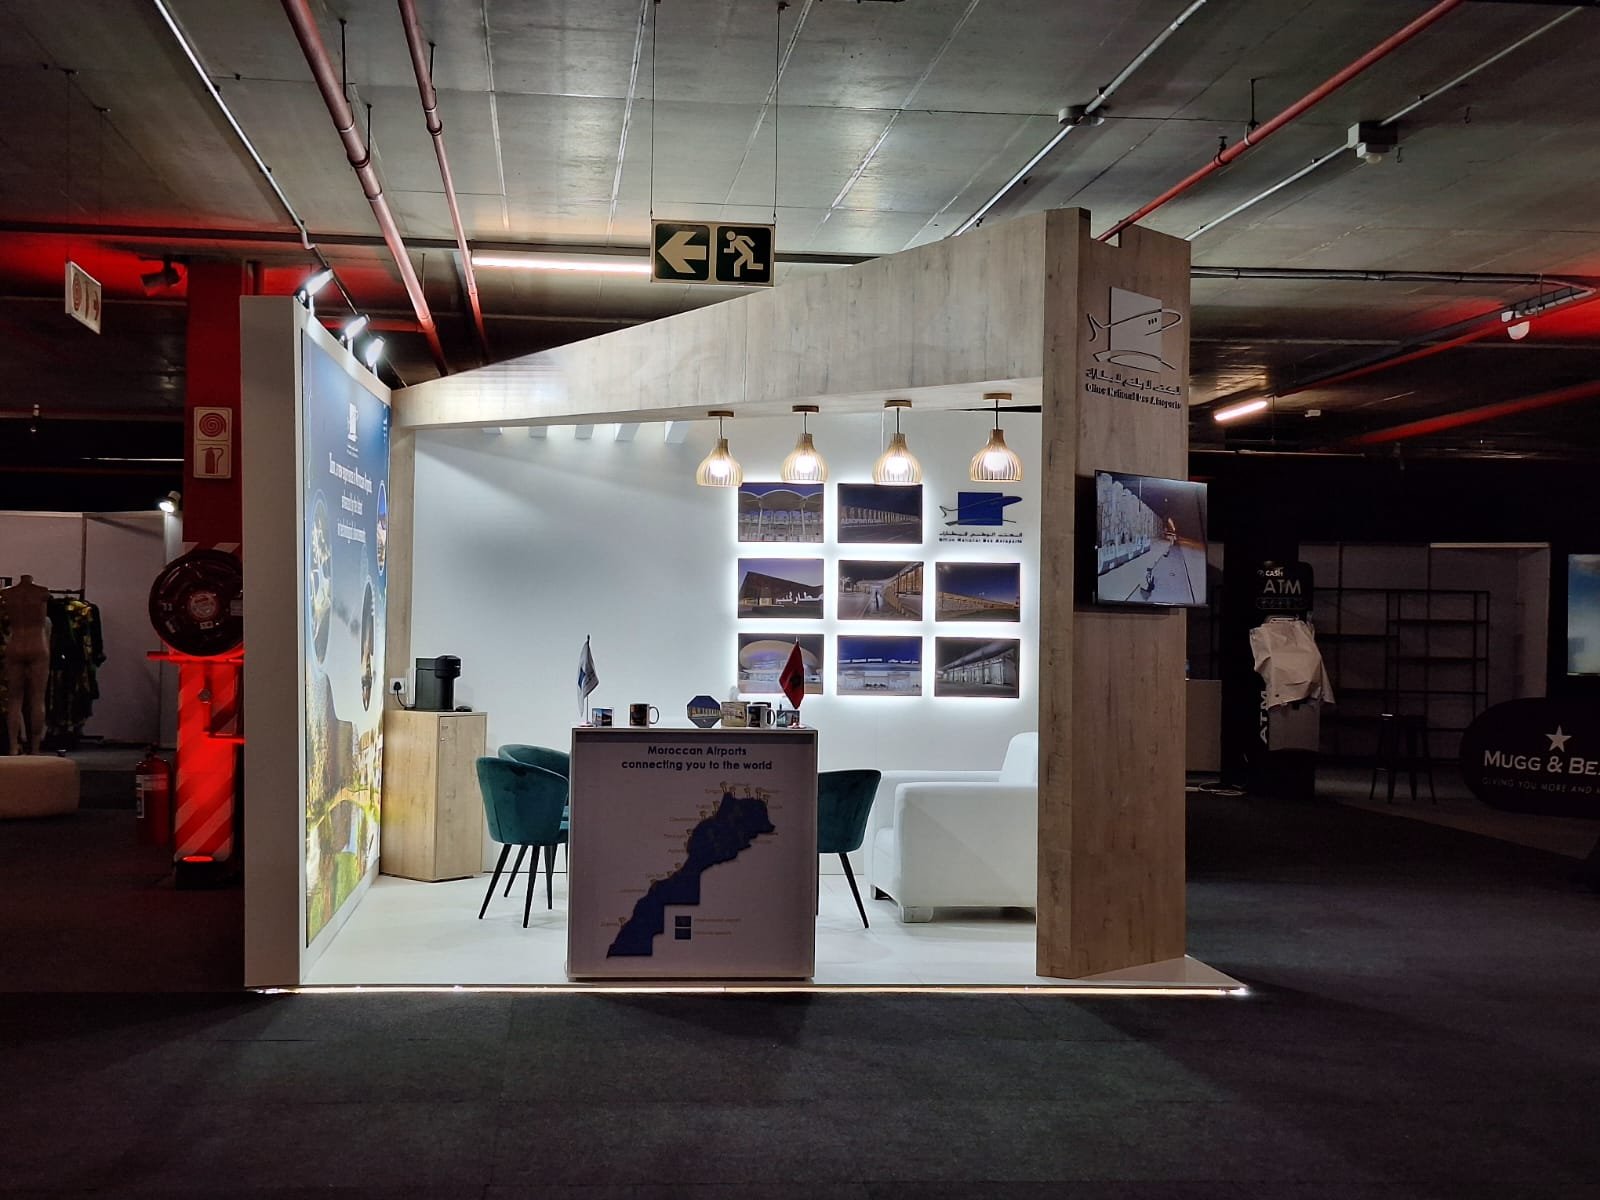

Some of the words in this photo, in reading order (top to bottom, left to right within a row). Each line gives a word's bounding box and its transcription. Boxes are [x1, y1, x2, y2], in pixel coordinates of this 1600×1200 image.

[1263, 579, 1302, 595] ATM
[647, 746, 703, 755] Moroccan
[706, 746, 747, 757] Airports
[621, 760, 683, 771] connecting
[686, 761, 706, 771] you
[709, 760, 720, 769] to
[723, 760, 740, 769] the
[743, 760, 773, 769] world
[1546, 755, 1564, 773] &
[1568, 757, 1600, 776] BE
[1481, 777, 1514, 787] GIVING
[1518, 780, 1537, 790] YOU
[1540, 783, 1568, 793] MORE
[1570, 785, 1593, 795] AND
